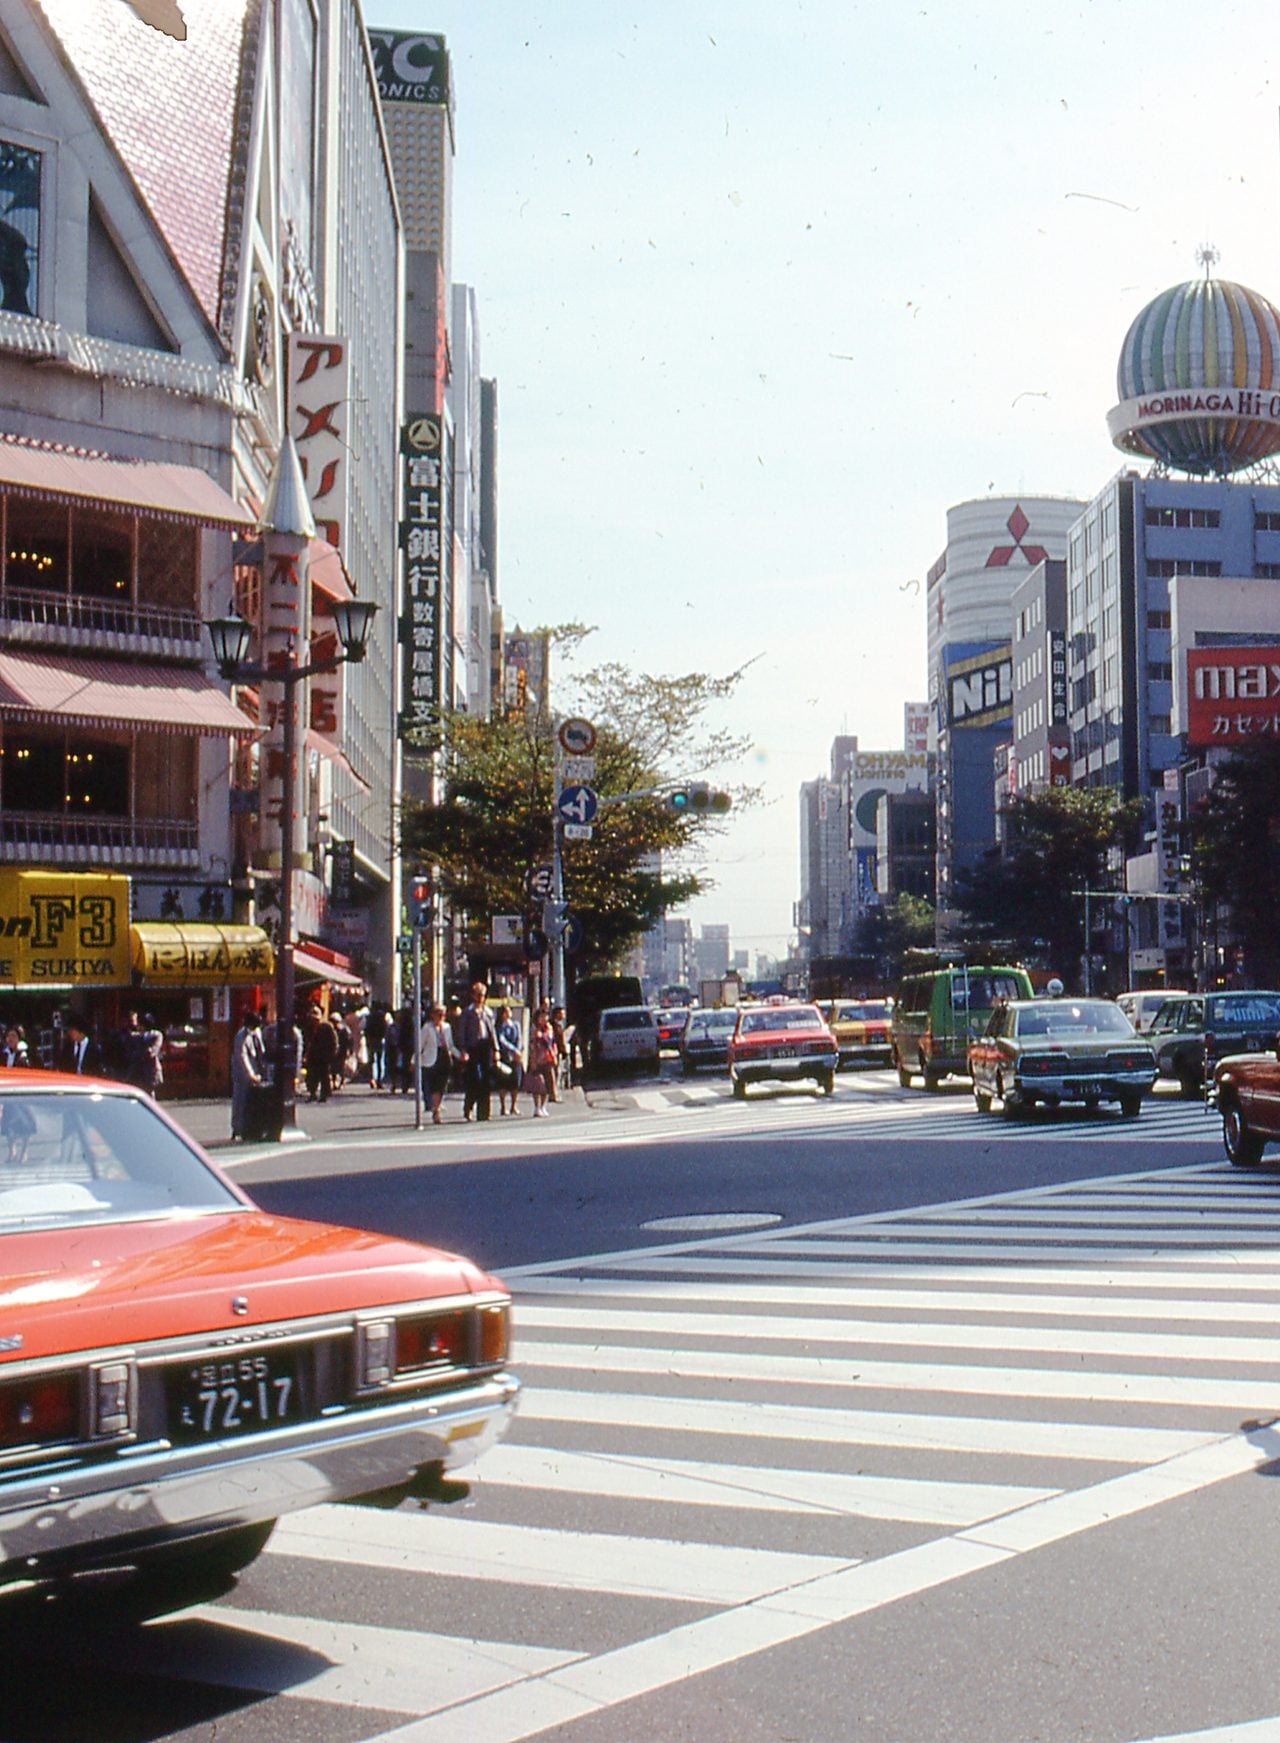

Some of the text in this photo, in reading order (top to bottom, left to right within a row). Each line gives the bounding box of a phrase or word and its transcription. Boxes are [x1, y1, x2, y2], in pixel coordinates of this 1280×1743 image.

[1137, 393, 1234, 419] MORINAGA
[1053, 639, 1066, 718] 安田生命
[0, 915, 33, 938] n
[30, 894, 117, 949] F3
[30, 959, 115, 977] SUKIYA
[198, 1377, 293, 1432] 72-17
